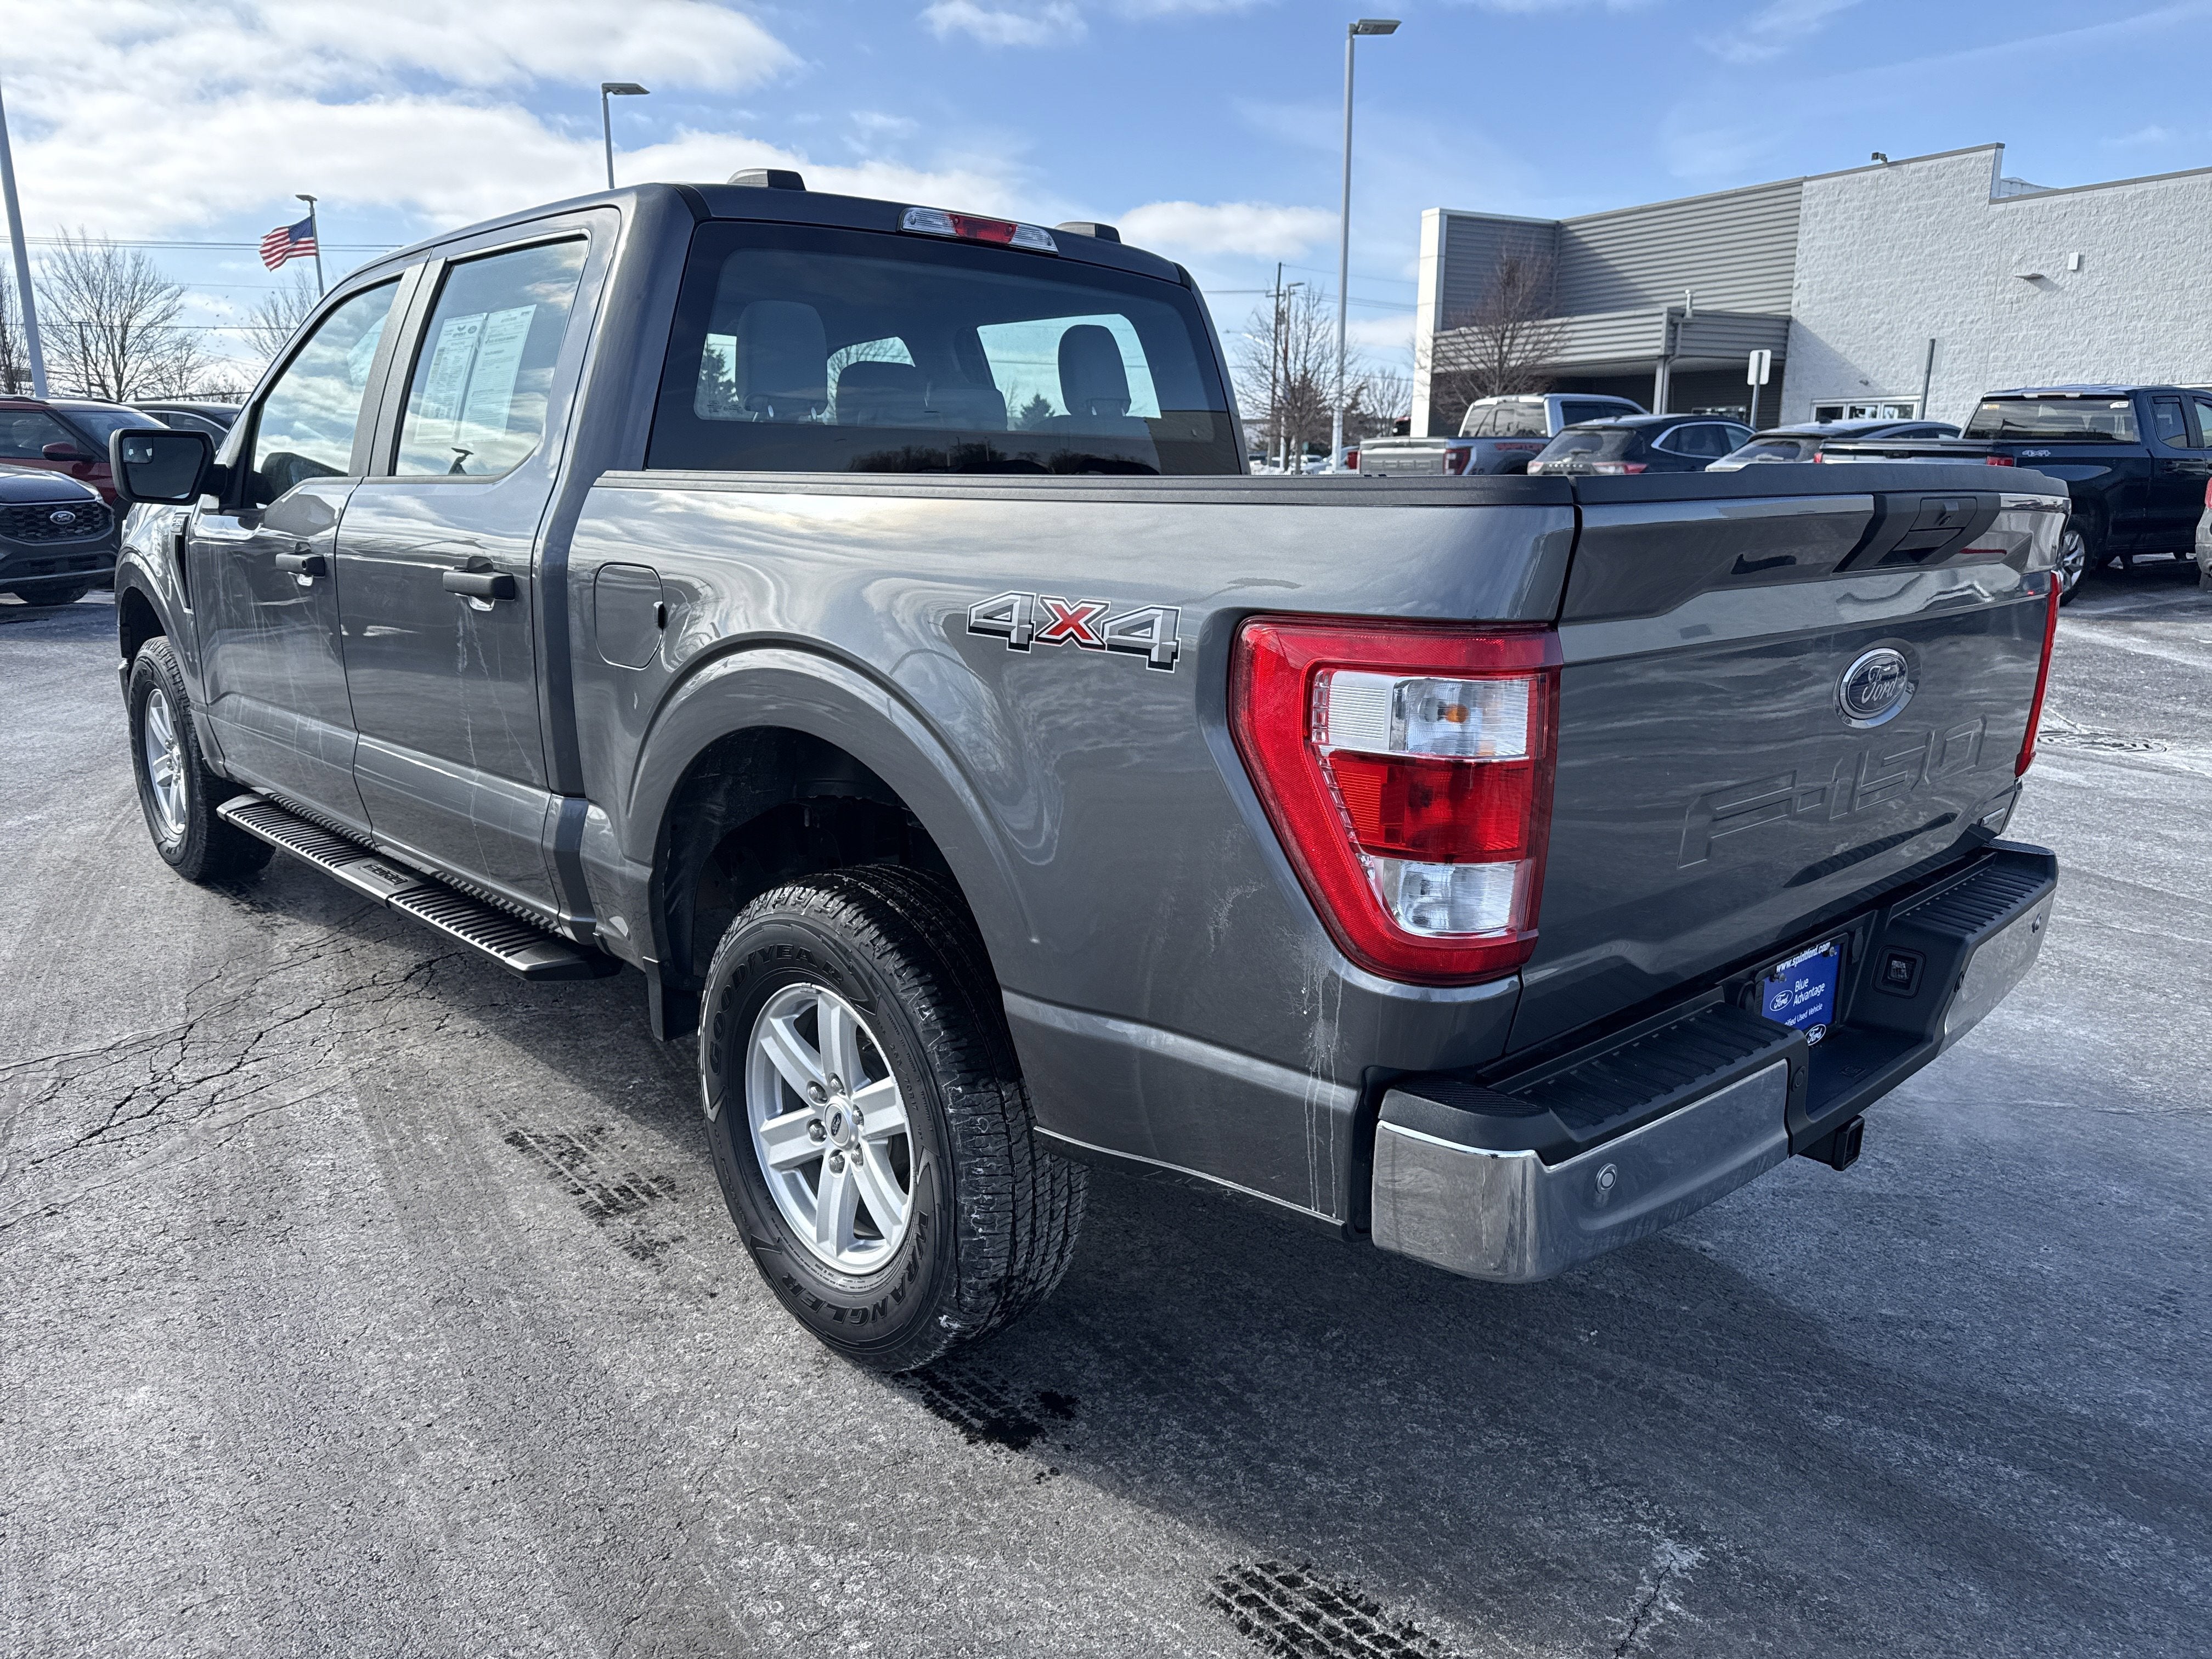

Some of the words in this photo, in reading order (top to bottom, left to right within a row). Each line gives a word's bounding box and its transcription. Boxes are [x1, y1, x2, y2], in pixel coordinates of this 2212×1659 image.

[1861, 664, 1900, 704] Ford
[363, 865, 405, 884] FORD
[1795, 978, 1809, 992] Blue
[1774, 993, 1790, 1009] Ford
[1793, 983, 1825, 1007] Advantage
[710, 944, 843, 1075] GOODYEAR
[1797, 1009, 1808, 1022] Used
[1808, 1003, 1823, 1016] Vehicle
[1807, 1027, 1822, 1044] Ford
[782, 1210, 929, 1326] WRANGLER
